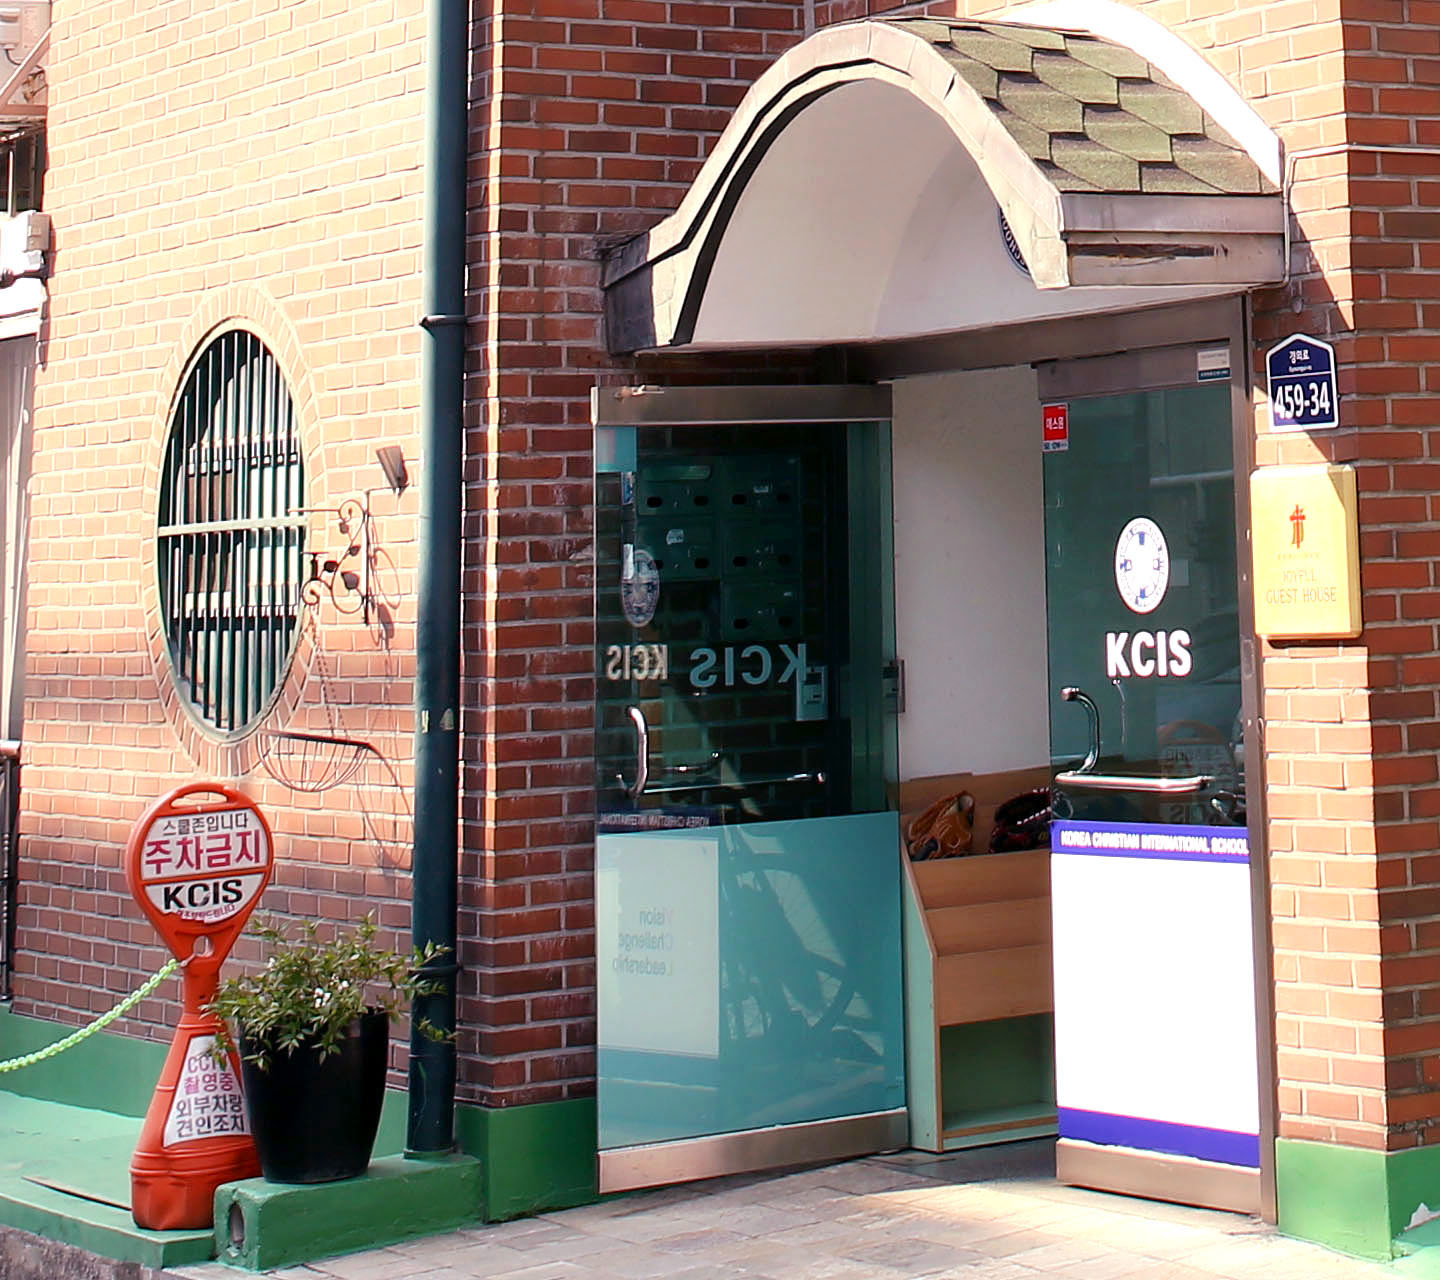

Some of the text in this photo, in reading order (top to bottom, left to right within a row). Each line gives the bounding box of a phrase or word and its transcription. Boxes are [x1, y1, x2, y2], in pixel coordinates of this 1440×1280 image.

[1273, 381, 1331, 420] 459-34
[1265, 586, 1337, 605] GUEST HOUSE
[1105, 629, 1193, 678] KCIS
[162, 812, 248, 836] 스쿨존입니다
[144, 829, 261, 875] 주차금지
[1061, 830, 1250, 855] KOREA CHRISTIAN INTERNATIONAL SCHOOL
[163, 878, 244, 910] KCIS
[184, 1072, 234, 1095] 촬영중
[176, 1093, 242, 1119] 외부차량
[176, 1114, 245, 1139] 견인조치
